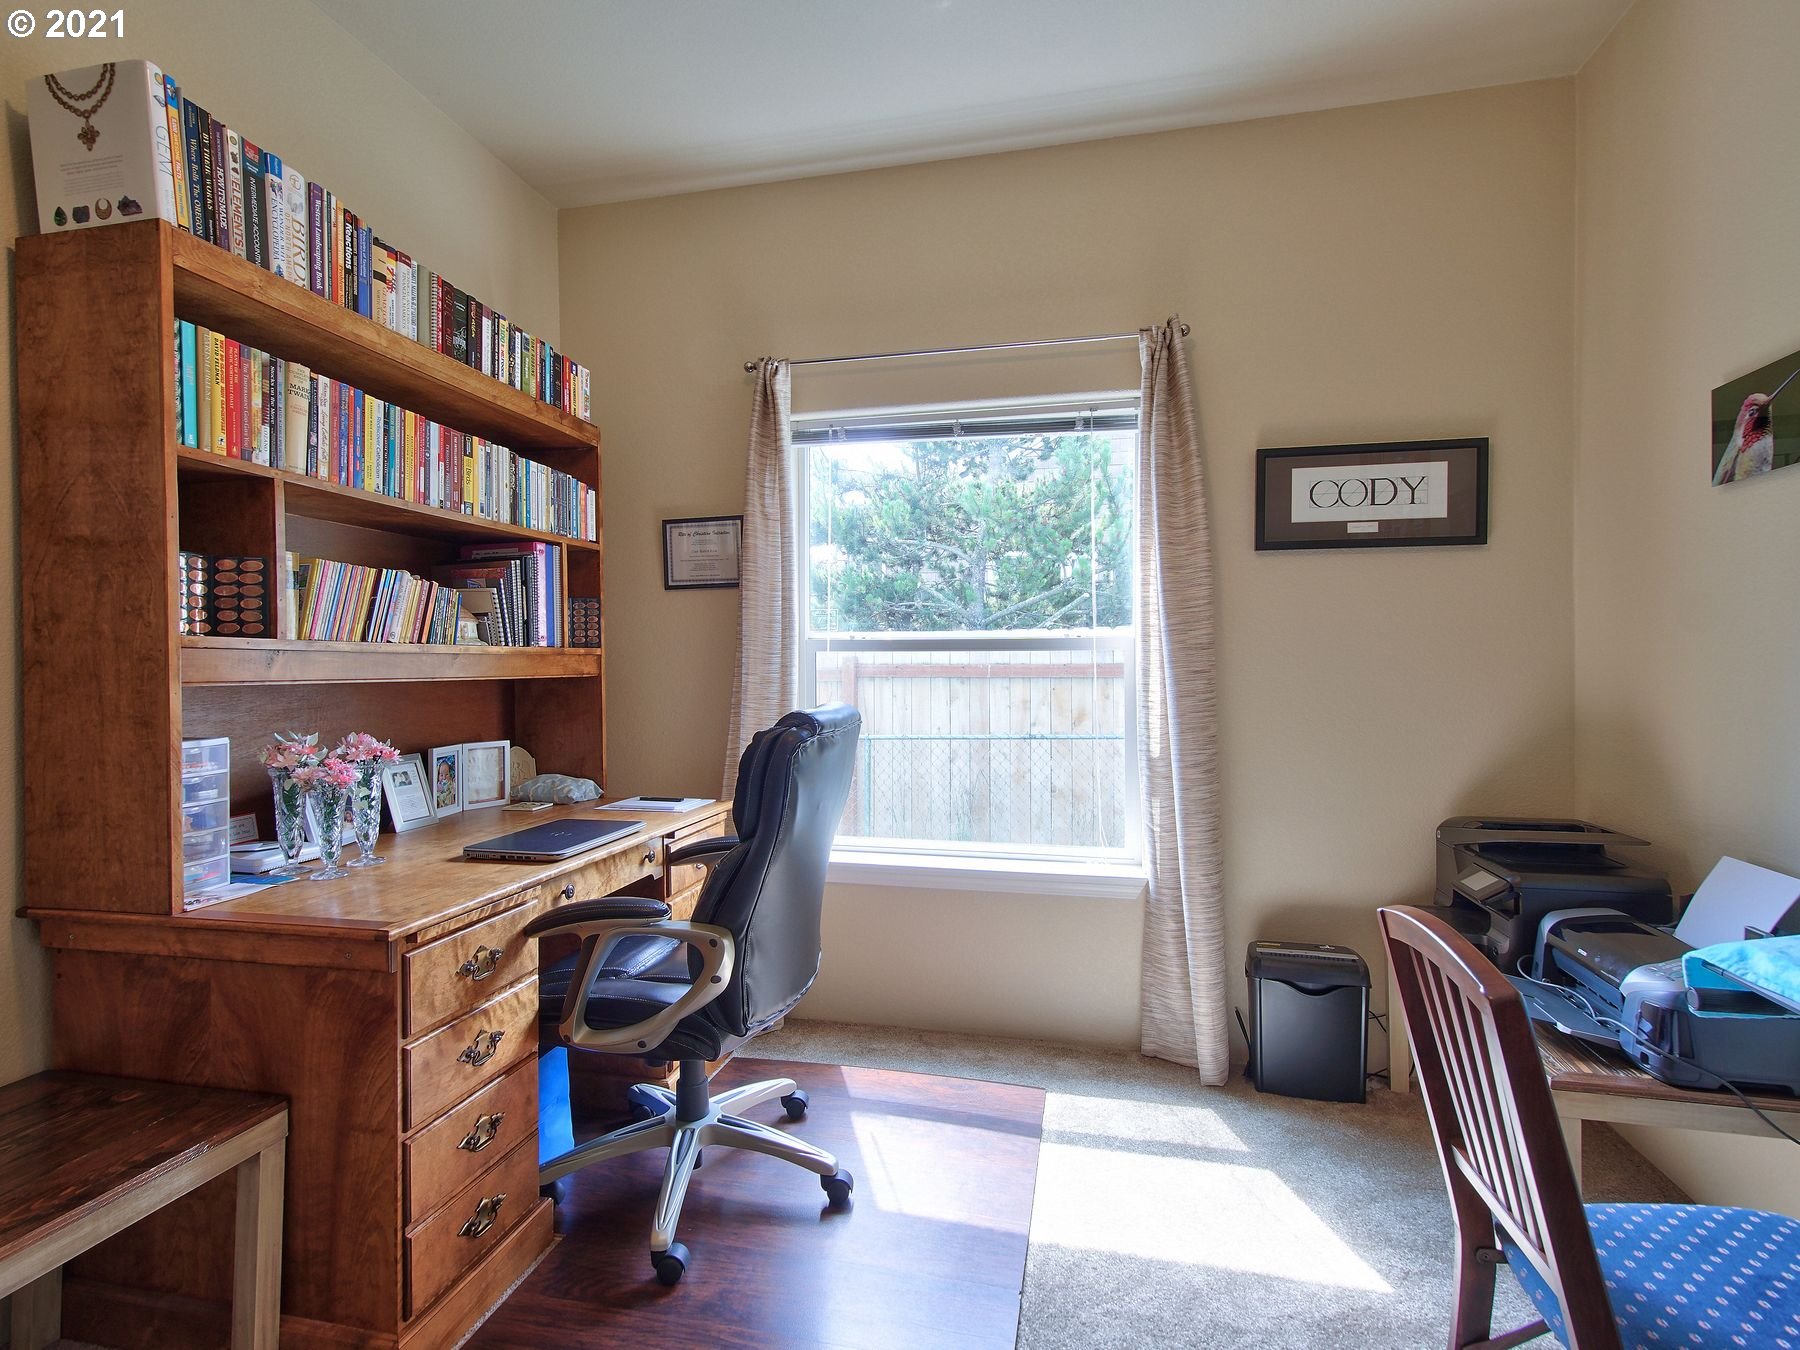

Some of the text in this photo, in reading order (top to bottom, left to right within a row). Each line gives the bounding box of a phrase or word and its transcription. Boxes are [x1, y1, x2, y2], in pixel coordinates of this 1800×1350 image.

[155, 125, 173, 178] GEM
[202, 132, 210, 144] BY
[203, 147, 211, 174] THEIR
[216, 166, 226, 186] HOW
[190, 138, 204, 237] Where Rolls The OREGON
[206, 178, 214, 211] WORKS
[249, 176, 259, 224] INTERMEDIATE
[218, 202, 228, 230] MADE
[231, 180, 244, 248] ELEMENTS
[272, 198, 280, 260] ENCYCLOPEDIA
[252, 224, 262, 268] ACCOUNTIN
[314, 228, 322, 270] Landscaping
[345, 222, 353, 270] Reactions
[316, 271, 324, 289] Book
[1309, 476, 1428, 508] CODY
